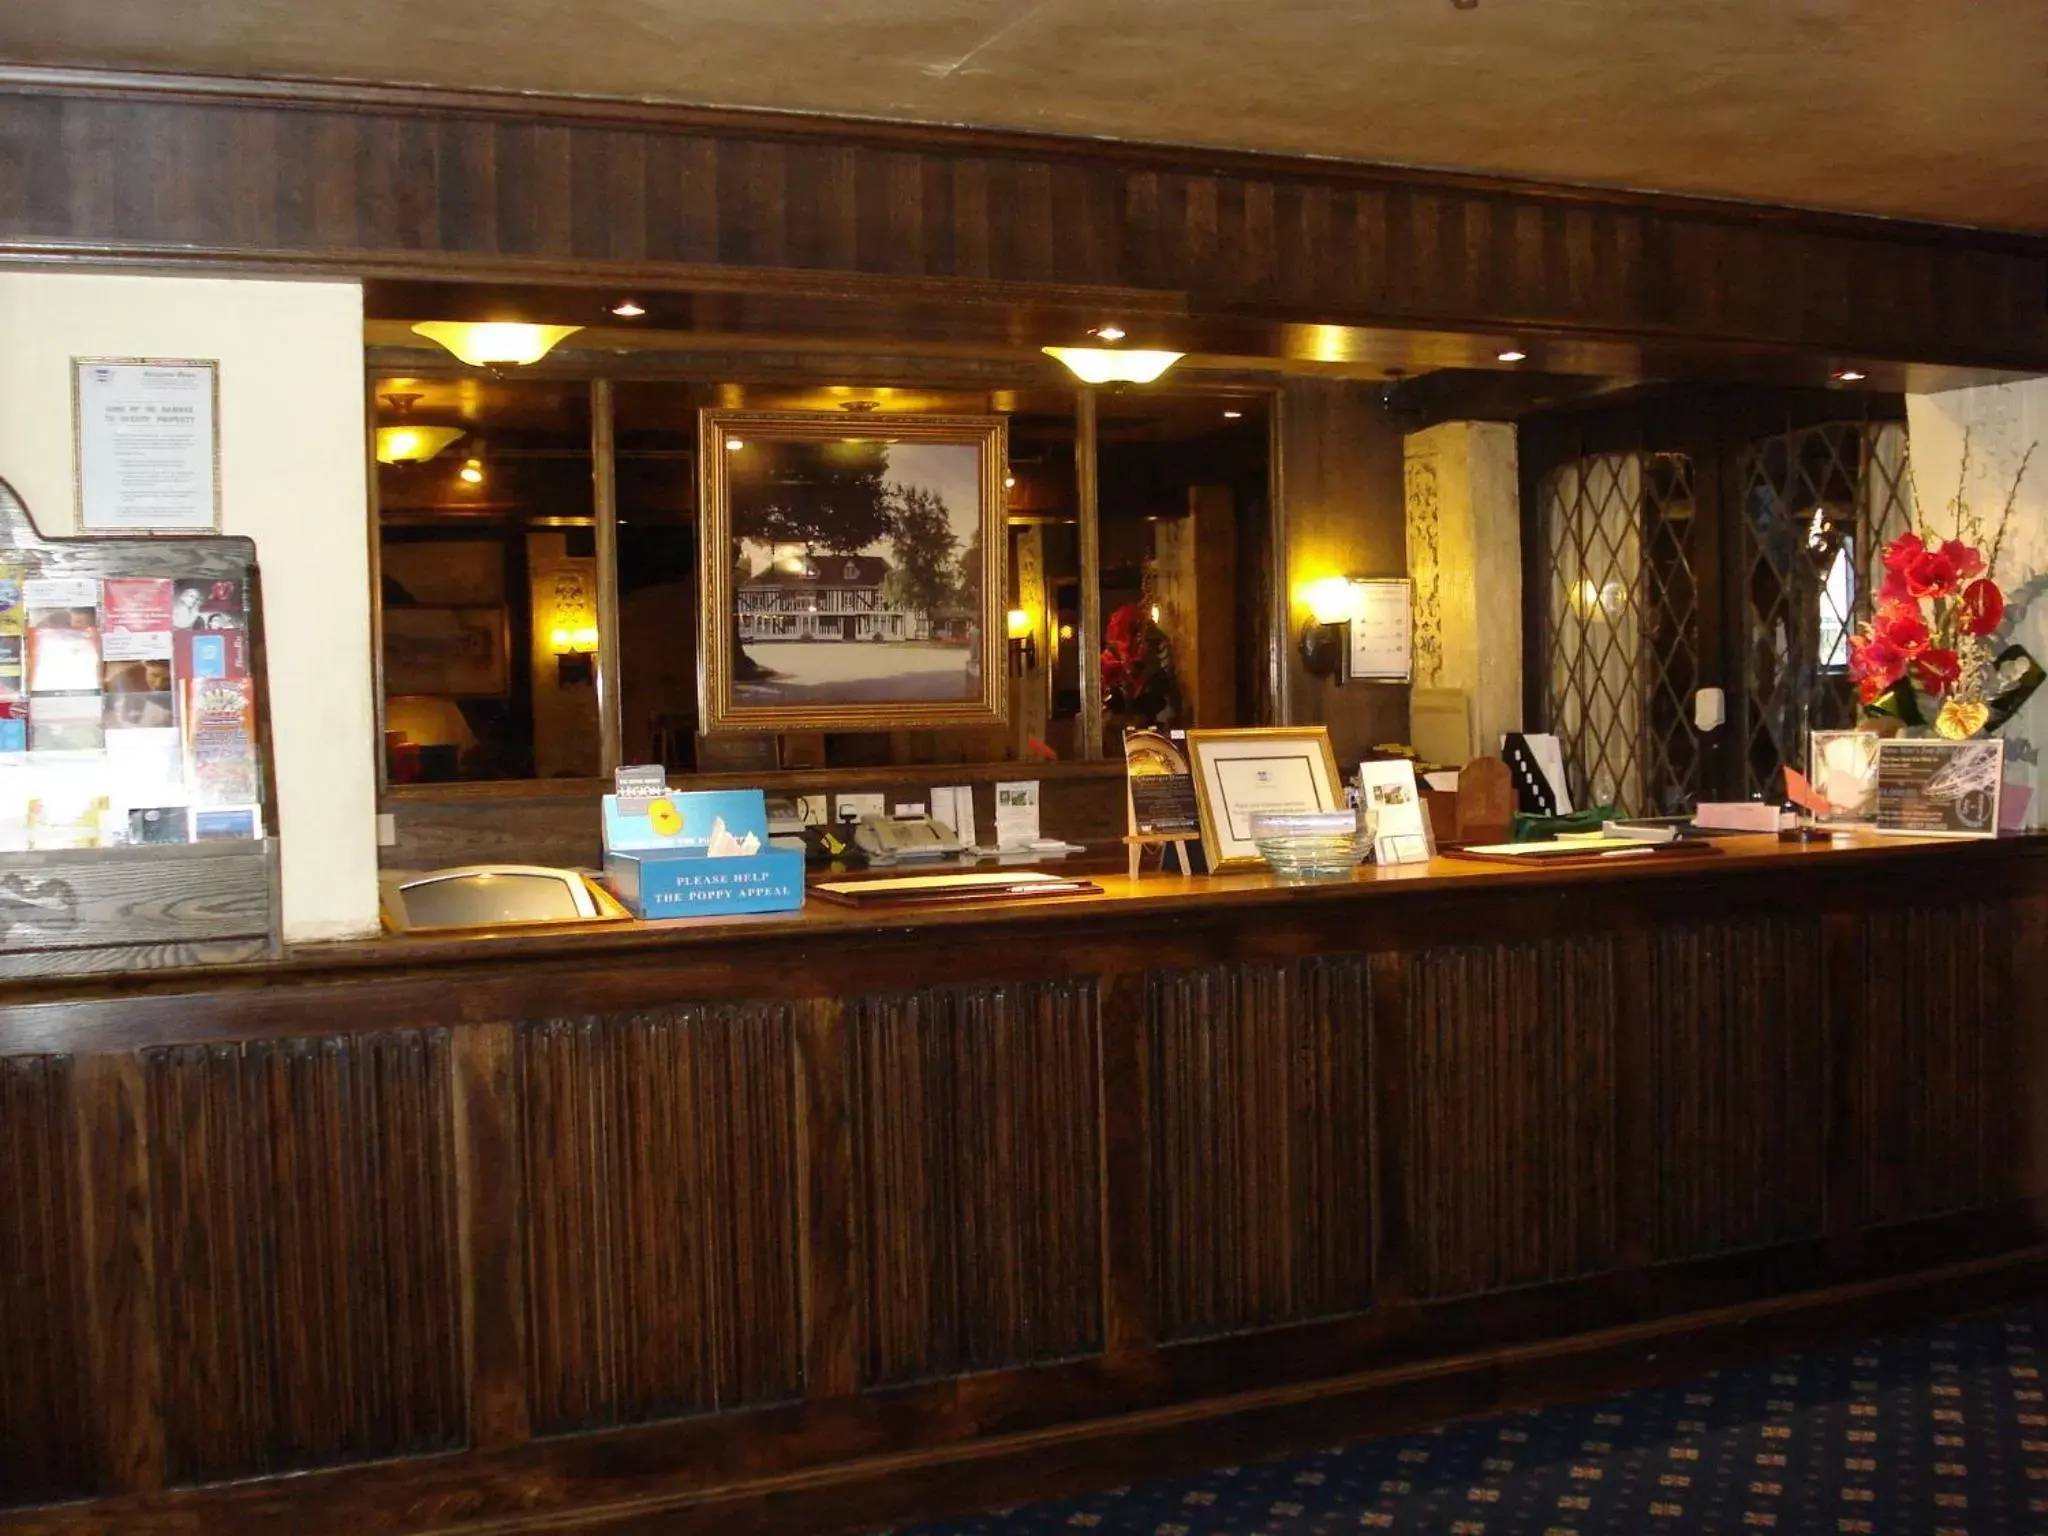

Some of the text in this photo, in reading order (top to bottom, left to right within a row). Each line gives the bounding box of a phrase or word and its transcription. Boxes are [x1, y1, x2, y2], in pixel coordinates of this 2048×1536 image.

[676, 872, 770, 887] PLEASE HELP
[654, 886, 791, 904] THE POPPY APPEAL
